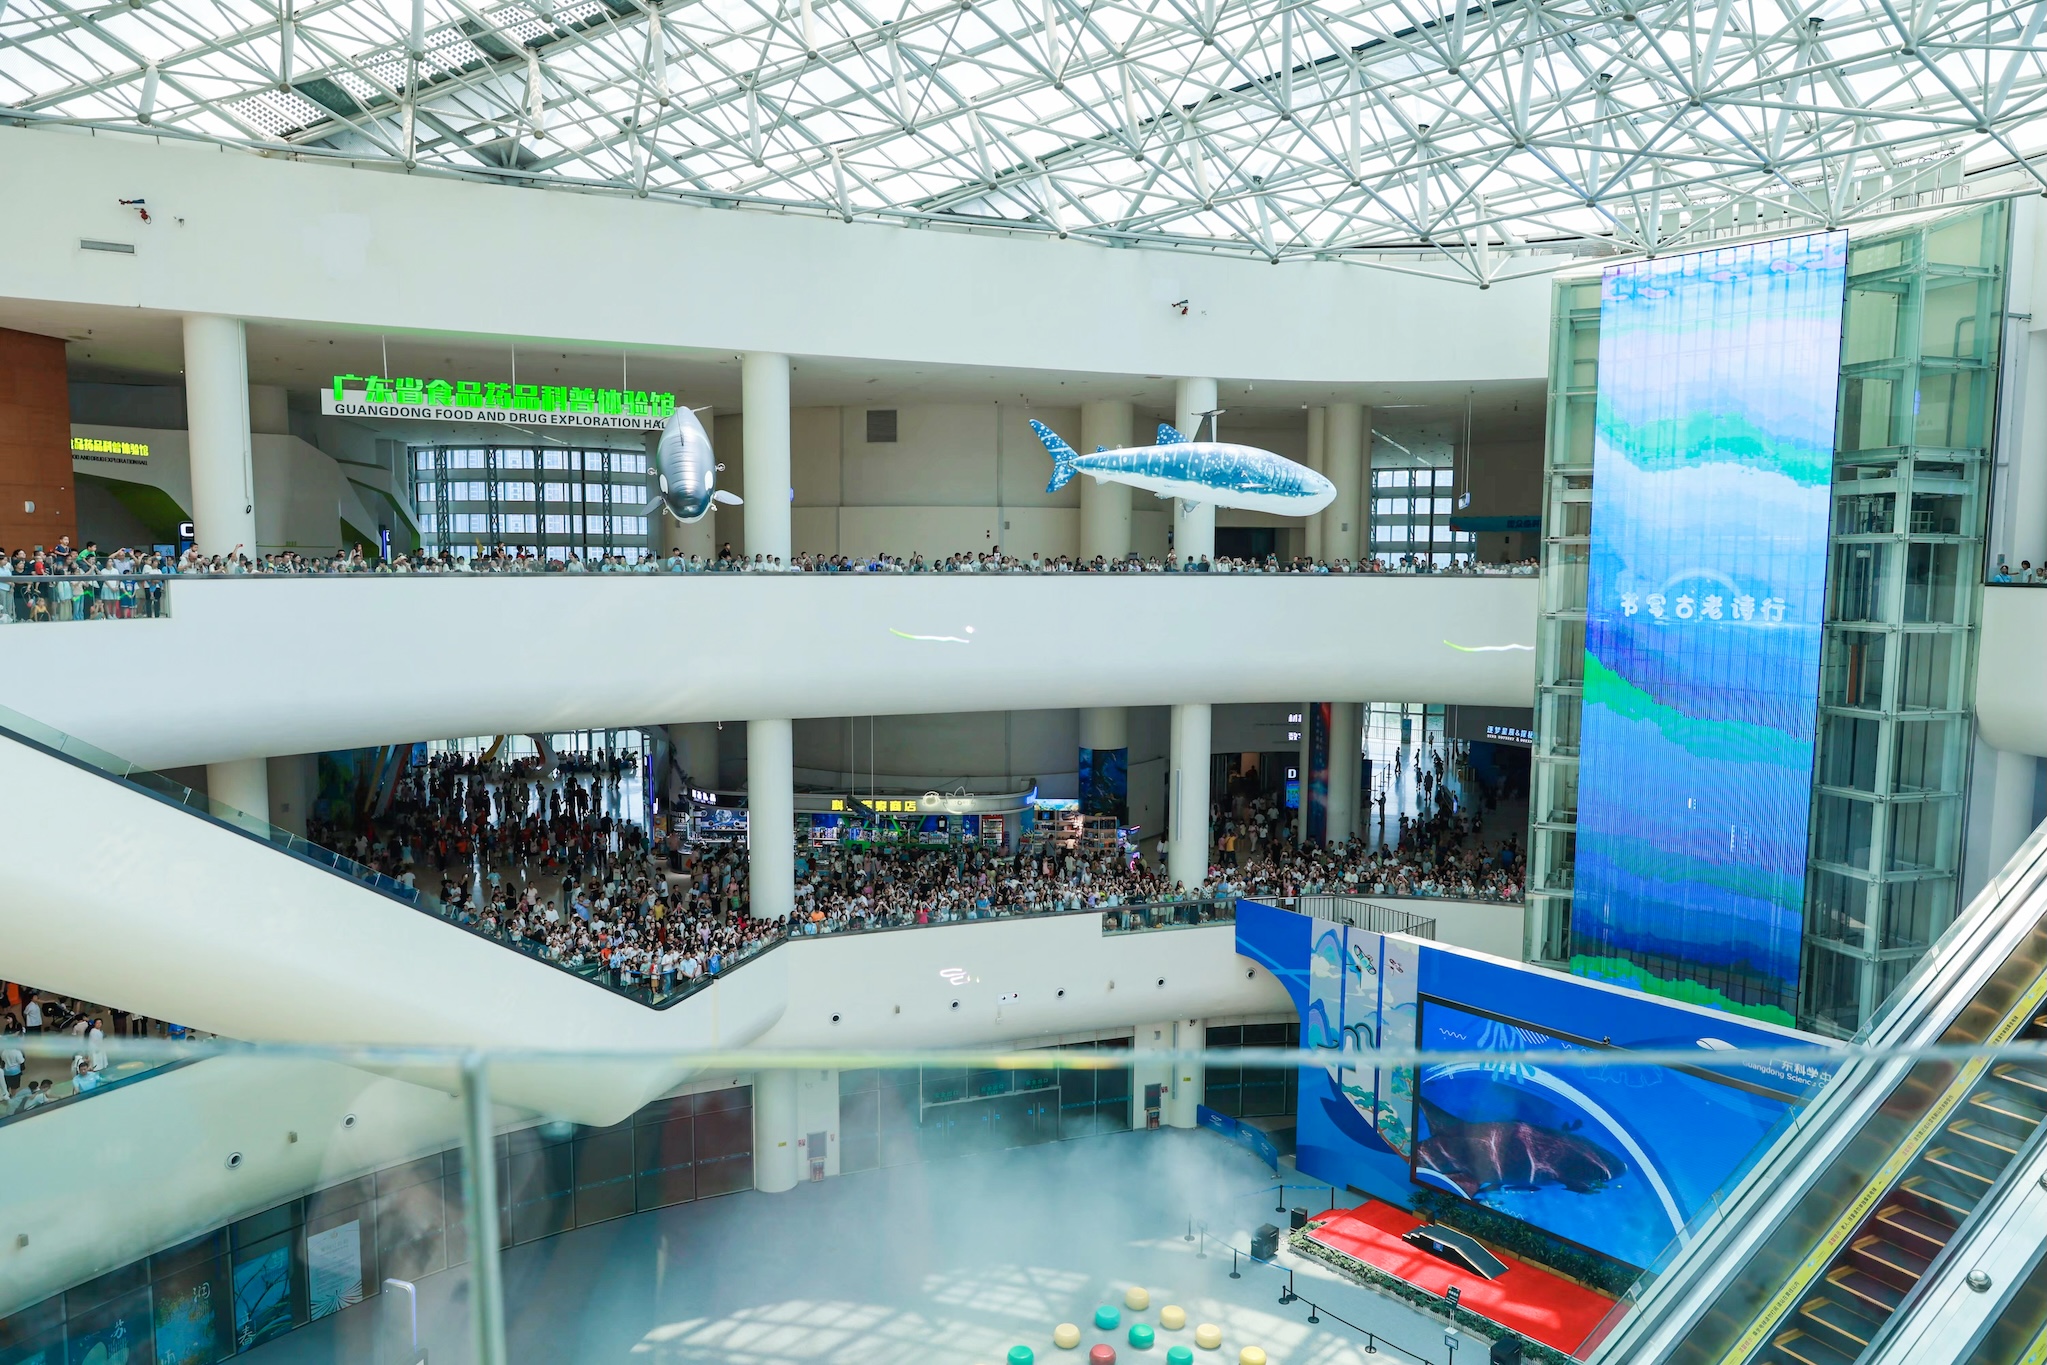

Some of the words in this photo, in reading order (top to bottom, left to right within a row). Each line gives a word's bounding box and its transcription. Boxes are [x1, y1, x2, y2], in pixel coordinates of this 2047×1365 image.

[333, 374, 676, 417] 广东省食品药品科普体验馆
[335, 403, 432, 419] GUANGDONG
[435, 409, 474, 421] FOOD
[477, 411, 506, 423] AND
[509, 412, 547, 424] DRUG
[551, 415, 641, 429] EXPLORATION
[644, 419, 667, 430] HAL
[70, 437, 149, 456] 品药品科普体验馆
[1620, 592, 1786, 622] 书写古老诗行
[1287, 768, 1297, 779] D
[831, 799, 917, 812] 科索商店
[1768, 1057, 1832, 1083] 广东科学中
